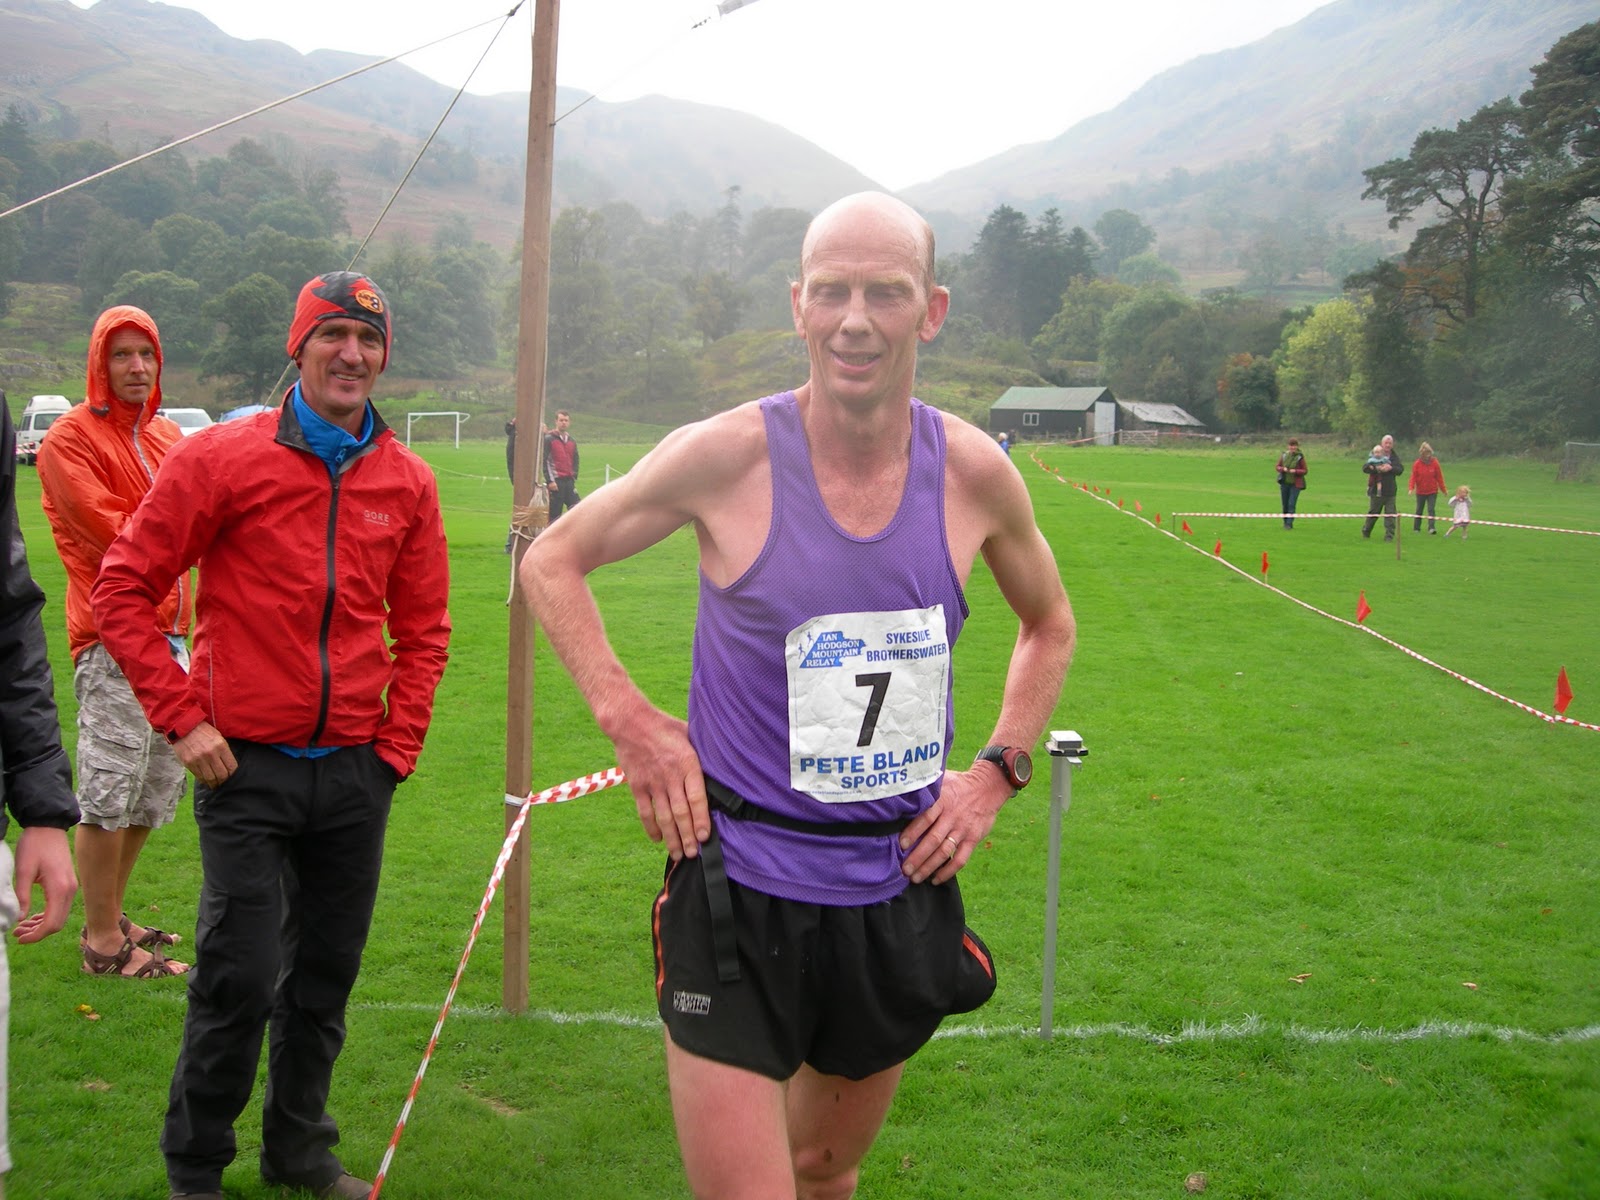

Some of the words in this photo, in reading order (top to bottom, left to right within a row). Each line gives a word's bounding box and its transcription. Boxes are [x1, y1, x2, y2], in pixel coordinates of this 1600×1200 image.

[364, 510, 390, 523] GORE
[822, 633, 838, 642] IAN
[886, 629, 931, 644] SYKESIDE
[816, 640, 860, 650] HODGSON
[812, 648, 859, 659] MOUNTAIN
[866, 643, 947, 662] BROTHERSWATER
[806, 658, 835, 667] RELAY
[855, 672, 892, 747] 7
[800, 756, 865, 774] PETE
[873, 742, 940, 771] BLAND
[841, 769, 908, 789] SPORTS
